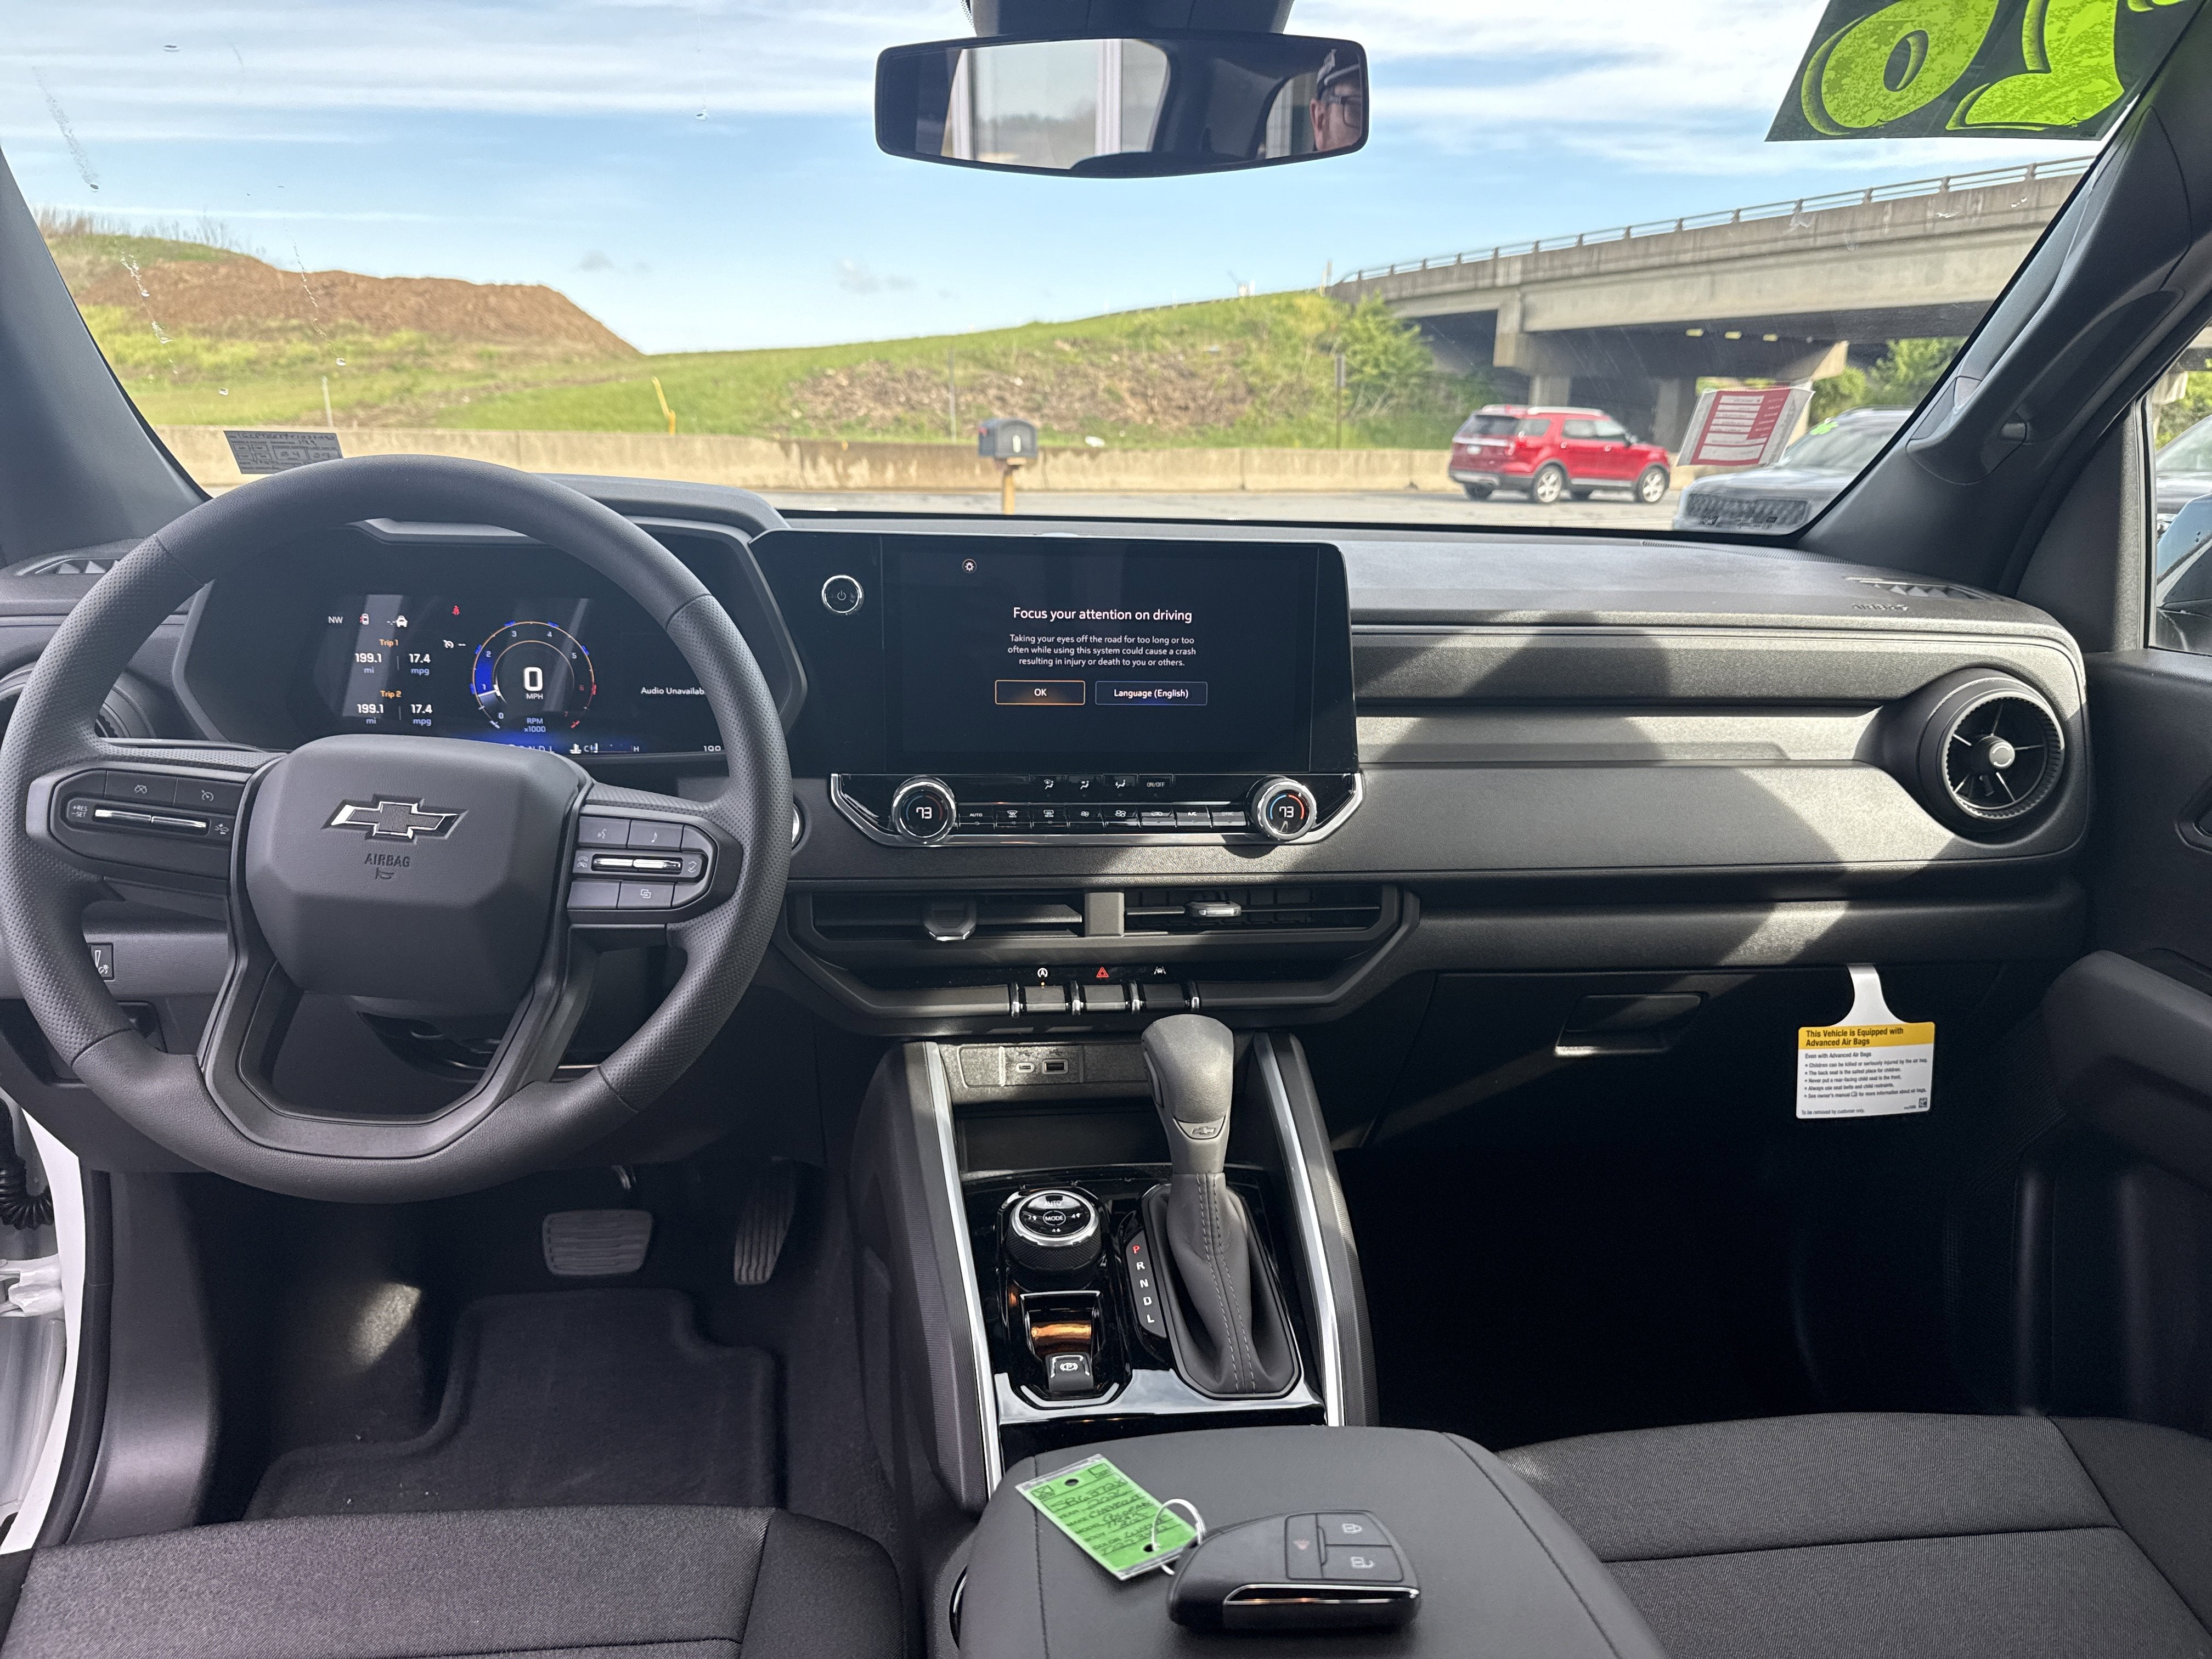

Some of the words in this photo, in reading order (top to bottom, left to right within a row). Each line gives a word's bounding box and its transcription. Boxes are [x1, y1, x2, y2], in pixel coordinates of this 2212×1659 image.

[328, 616, 343, 624] NW
[1013, 607, 1048, 619] Focus
[1049, 610, 1076, 622] your
[1079, 608, 1132, 620] attention
[1135, 611, 1150, 620] on
[1153, 608, 1192, 624] driving
[379, 639, 394, 647] Trip
[1009, 634, 1036, 644] Taking
[1037, 636, 1054, 644] your
[1057, 636, 1074, 645] eyes
[1076, 634, 1088, 643] off
[1090, 635, 1102, 643] the
[1104, 635, 1122, 644] road
[1124, 635, 1136, 644] for
[1152, 636, 1169, 646] long
[1007, 645, 1029, 653] often
[1031, 646, 1052, 654] while
[1053, 646, 1074, 656] using
[1076, 646, 1091, 654] this
[1093, 647, 1120, 656] system
[1122, 646, 1143, 654] could
[355, 653, 382, 663] 199.1
[409, 653, 431, 663] 17.4
[1019, 657, 1053, 667] resulting
[1064, 658, 1086, 667] injury
[1132, 659, 1146, 668] you
[411, 667, 430, 676] mpg
[523, 667, 543, 692] 0
[380, 690, 395, 699] Trip
[665, 687, 706, 695] Unavailab
[1114, 689, 1152, 699] Language
[1154, 689, 1189, 699] (English)
[357, 704, 384, 714] 199.1
[411, 704, 433, 714] 17.4
[413, 718, 432, 726] mpg
[916, 806, 933, 819] 73
[1279, 806, 1294, 818] 73
[364, 853, 411, 867] AIRBAG
[1806, 1030, 1821, 1038] This
[1823, 1029, 1848, 1037] Vehicle
[1857, 1028, 1888, 1037] Equipped
[1805, 1039, 1840, 1047] Advanced
[1853, 1037, 1870, 1046] Bags
[1132, 1245, 1141, 1254] P
[1136, 1262, 1145, 1271] R
[1139, 1279, 1149, 1288] N
[1143, 1296, 1152, 1306] D
[1147, 1314, 1155, 1323] L
[1059, 1509, 1080, 1519] YEAR
[1066, 1516, 1089, 1526] MAKE
[1075, 1523, 1101, 1534] MODEL
[1084, 1532, 1106, 1542] BODY
[1093, 1538, 1121, 1550] COLOR
